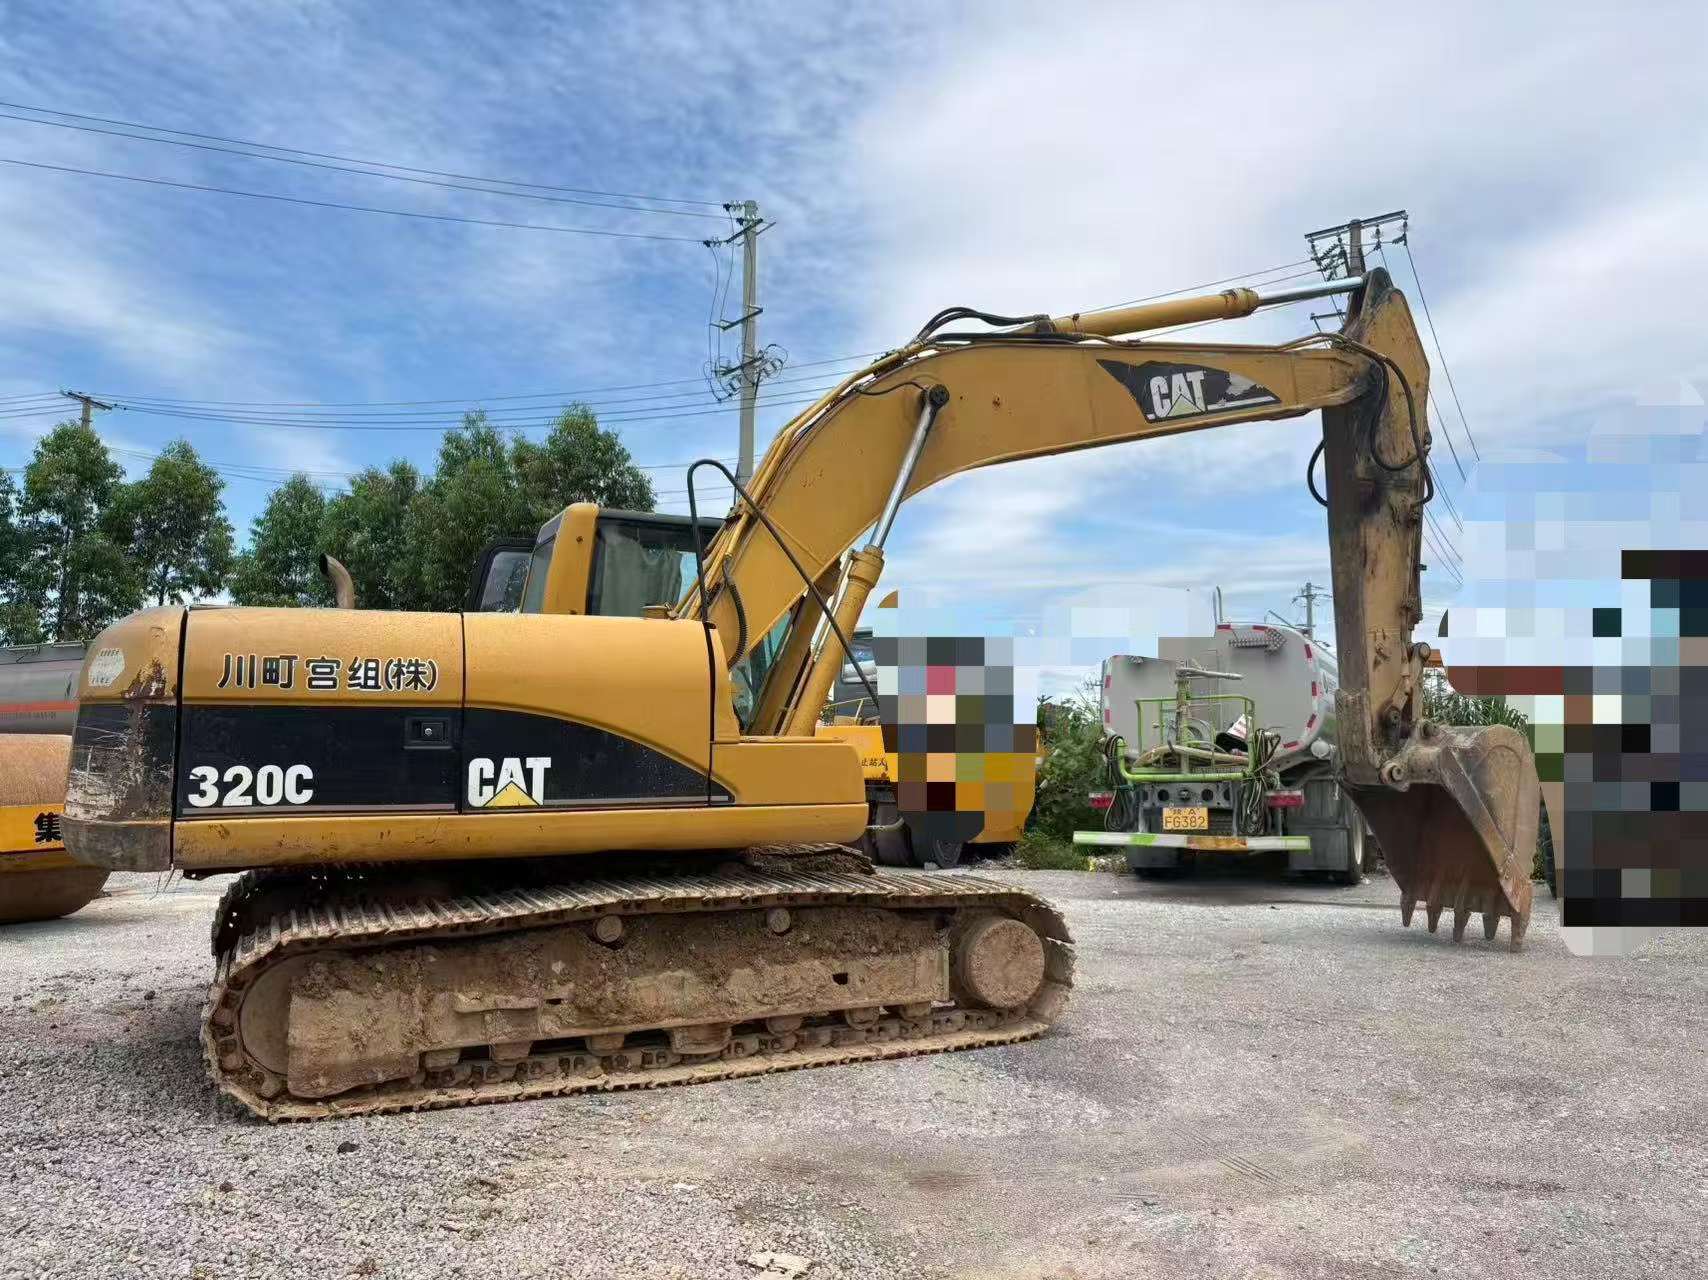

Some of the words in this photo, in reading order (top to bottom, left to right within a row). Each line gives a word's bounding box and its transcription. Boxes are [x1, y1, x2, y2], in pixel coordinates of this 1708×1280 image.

[1150, 370, 1207, 418] CAT
[188, 764, 314, 808] 320C
[468, 757, 551, 807] CAT
